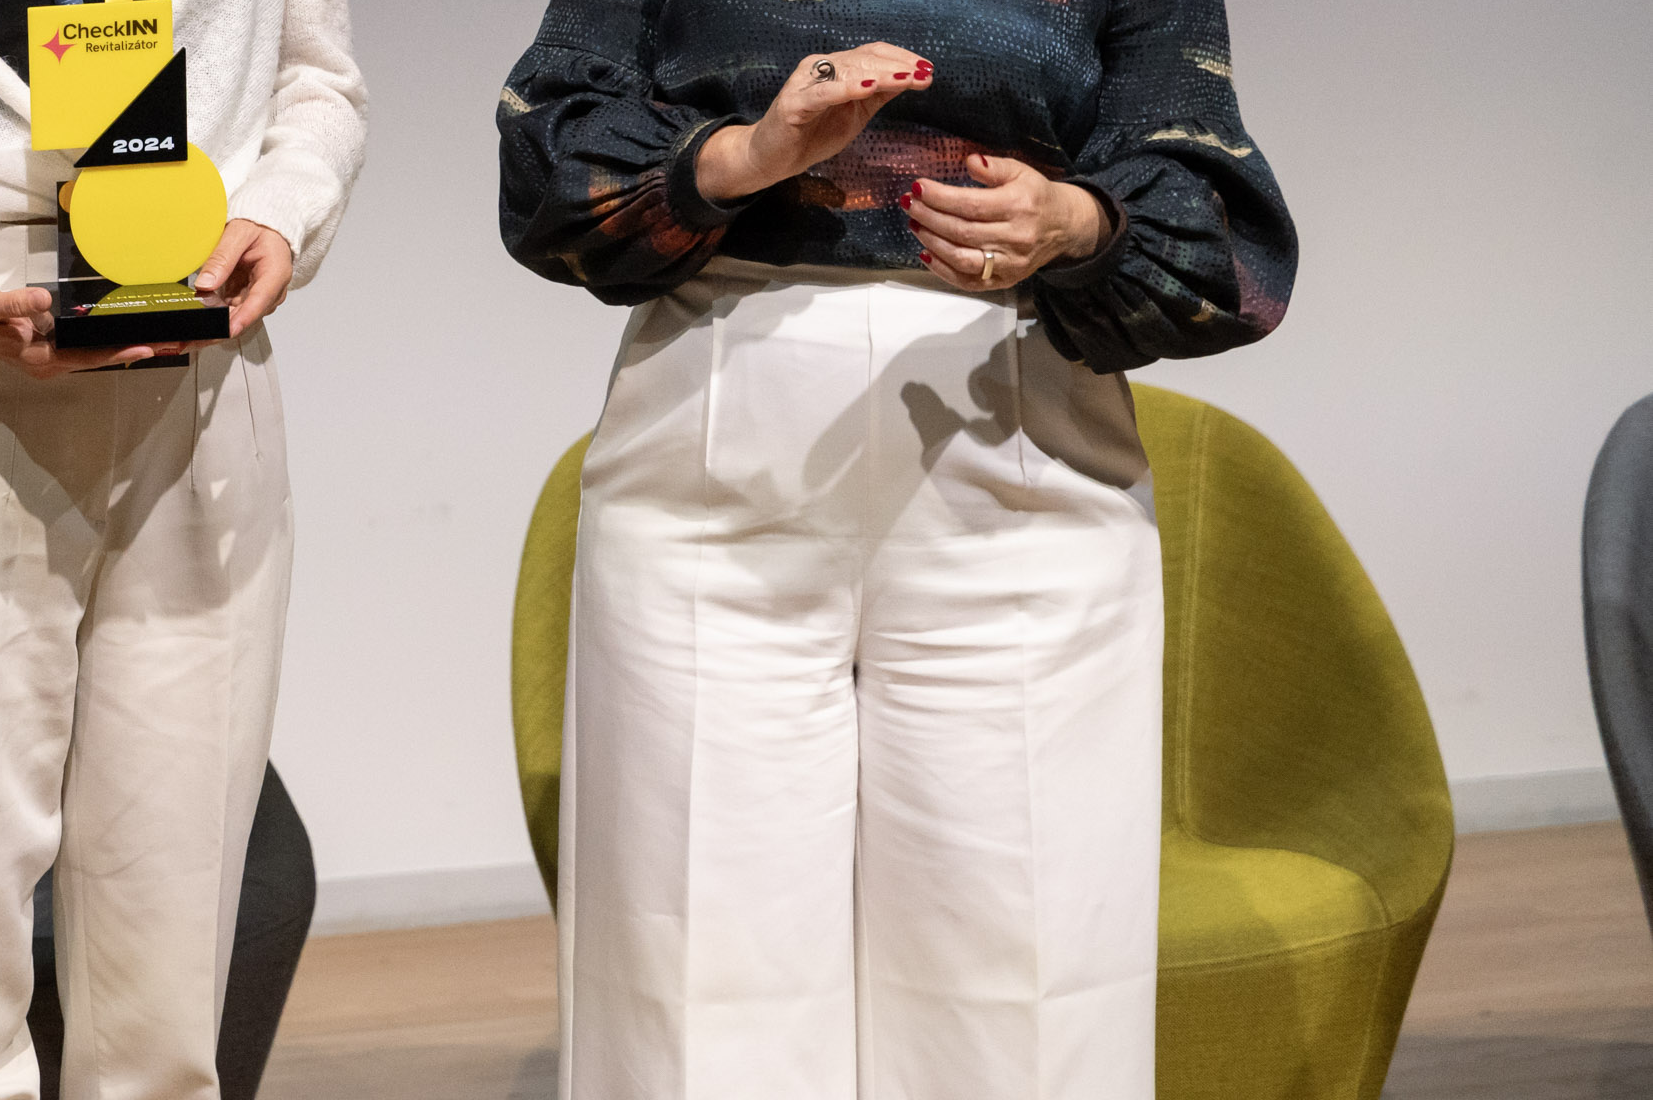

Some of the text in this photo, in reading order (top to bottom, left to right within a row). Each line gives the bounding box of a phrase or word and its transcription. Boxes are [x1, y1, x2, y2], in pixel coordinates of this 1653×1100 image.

[63, 18, 158, 40] CheckINN
[85, 39, 159, 53] Revitalizátor
[112, 136, 175, 154] 2024
